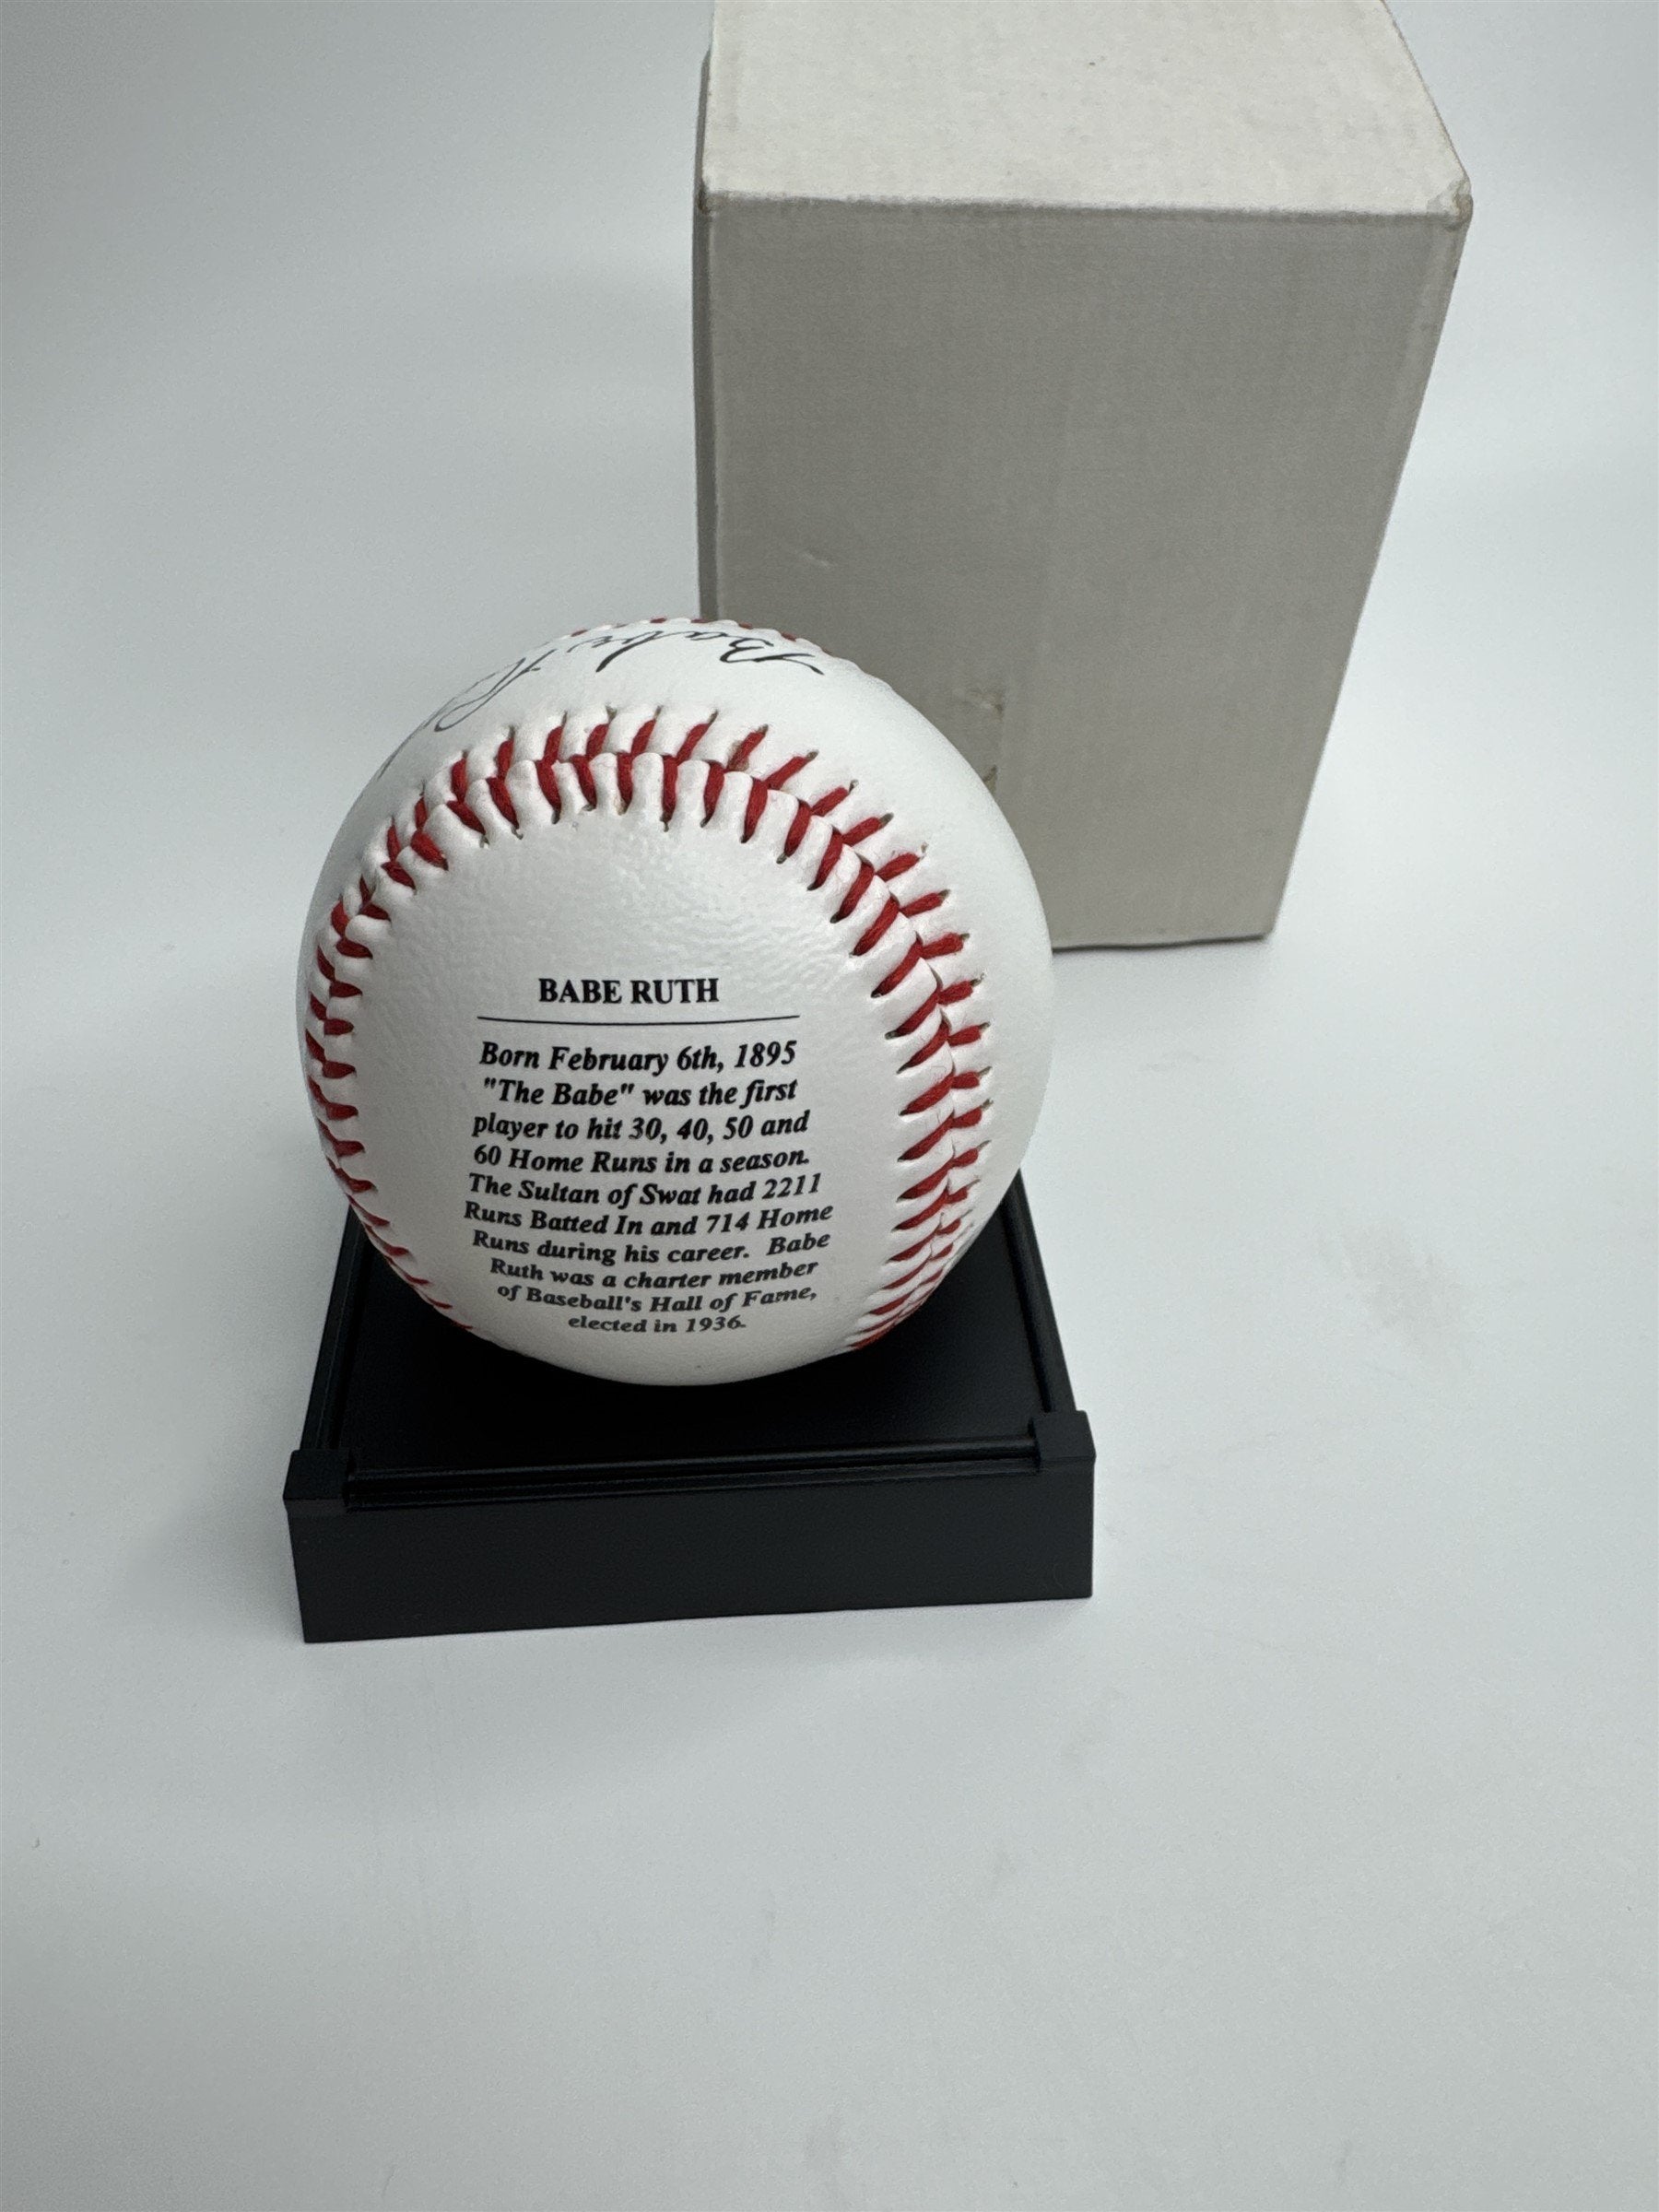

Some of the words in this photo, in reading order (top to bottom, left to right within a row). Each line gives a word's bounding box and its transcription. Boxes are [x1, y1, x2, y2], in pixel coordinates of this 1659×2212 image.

[537, 977, 623, 1005] BABE
[629, 977, 720, 1005] RUTH
[478, 1041, 540, 1070] Born
[547, 1045, 670, 1078] February
[676, 1044, 724, 1074] 6th,
[734, 1040, 798, 1068] 1895
[483, 1077, 546, 1105] "The
[550, 1082, 636, 1107] Babe"
[641, 1088, 692, 1107] was
[698, 1081, 739, 1107] the
[738, 1078, 799, 1111] first
[471, 1112, 549, 1142] player
[554, 1119, 580, 1140] to
[585, 1116, 623, 1141] hit
[628, 1116, 668, 1145] 30,
[676, 1117, 714, 1146] 40,
[722, 1114, 754, 1141] 50
[759, 1109, 811, 1137] and
[473, 1143, 502, 1167] 60
[507, 1147, 584, 1173] Home
[589, 1150, 658, 1174] Runs
[664, 1150, 691, 1174] in
[698, 1157, 714, 1174] a
[719, 1149, 810, 1174] season.
[468, 1171, 512, 1198] The
[517, 1179, 600, 1205] Sultan
[606, 1182, 639, 1211] of
[639, 1182, 702, 1206] Swat
[706, 1180, 758, 1206] had
[761, 1172, 822, 1200] 2211
[463, 1200, 523, 1228] Runs
[529, 1209, 610, 1235] Batted
[613, 1214, 643, 1236] In
[650, 1215, 700, 1237] and
[706, 1211, 750, 1234] 714
[756, 1205, 834, 1230] Home
[472, 1229, 530, 1255] Runs
[536, 1239, 618, 1267] during
[623, 1243, 660, 1264] his
[666, 1245, 750, 1264] career.
[765, 1231, 831, 1256] Babe
[489, 1257, 545, 1281] Ruth
[549, 1270, 595, 1287] was
[601, 1275, 618, 1288] a
[623, 1271, 712, 1289] charter
[717, 1261, 819, 1287] member
[497, 1284, 523, 1302] of
[525, 1286, 642, 1312] Baseball's
[649, 1295, 703, 1312] Hall
[709, 1292, 739, 1313] of
[741, 1287, 818, 1308] Fame,
[568, 1314, 648, 1333] elected
[653, 1319, 677, 1334] in
[685, 1314, 747, 1333] 1936.
